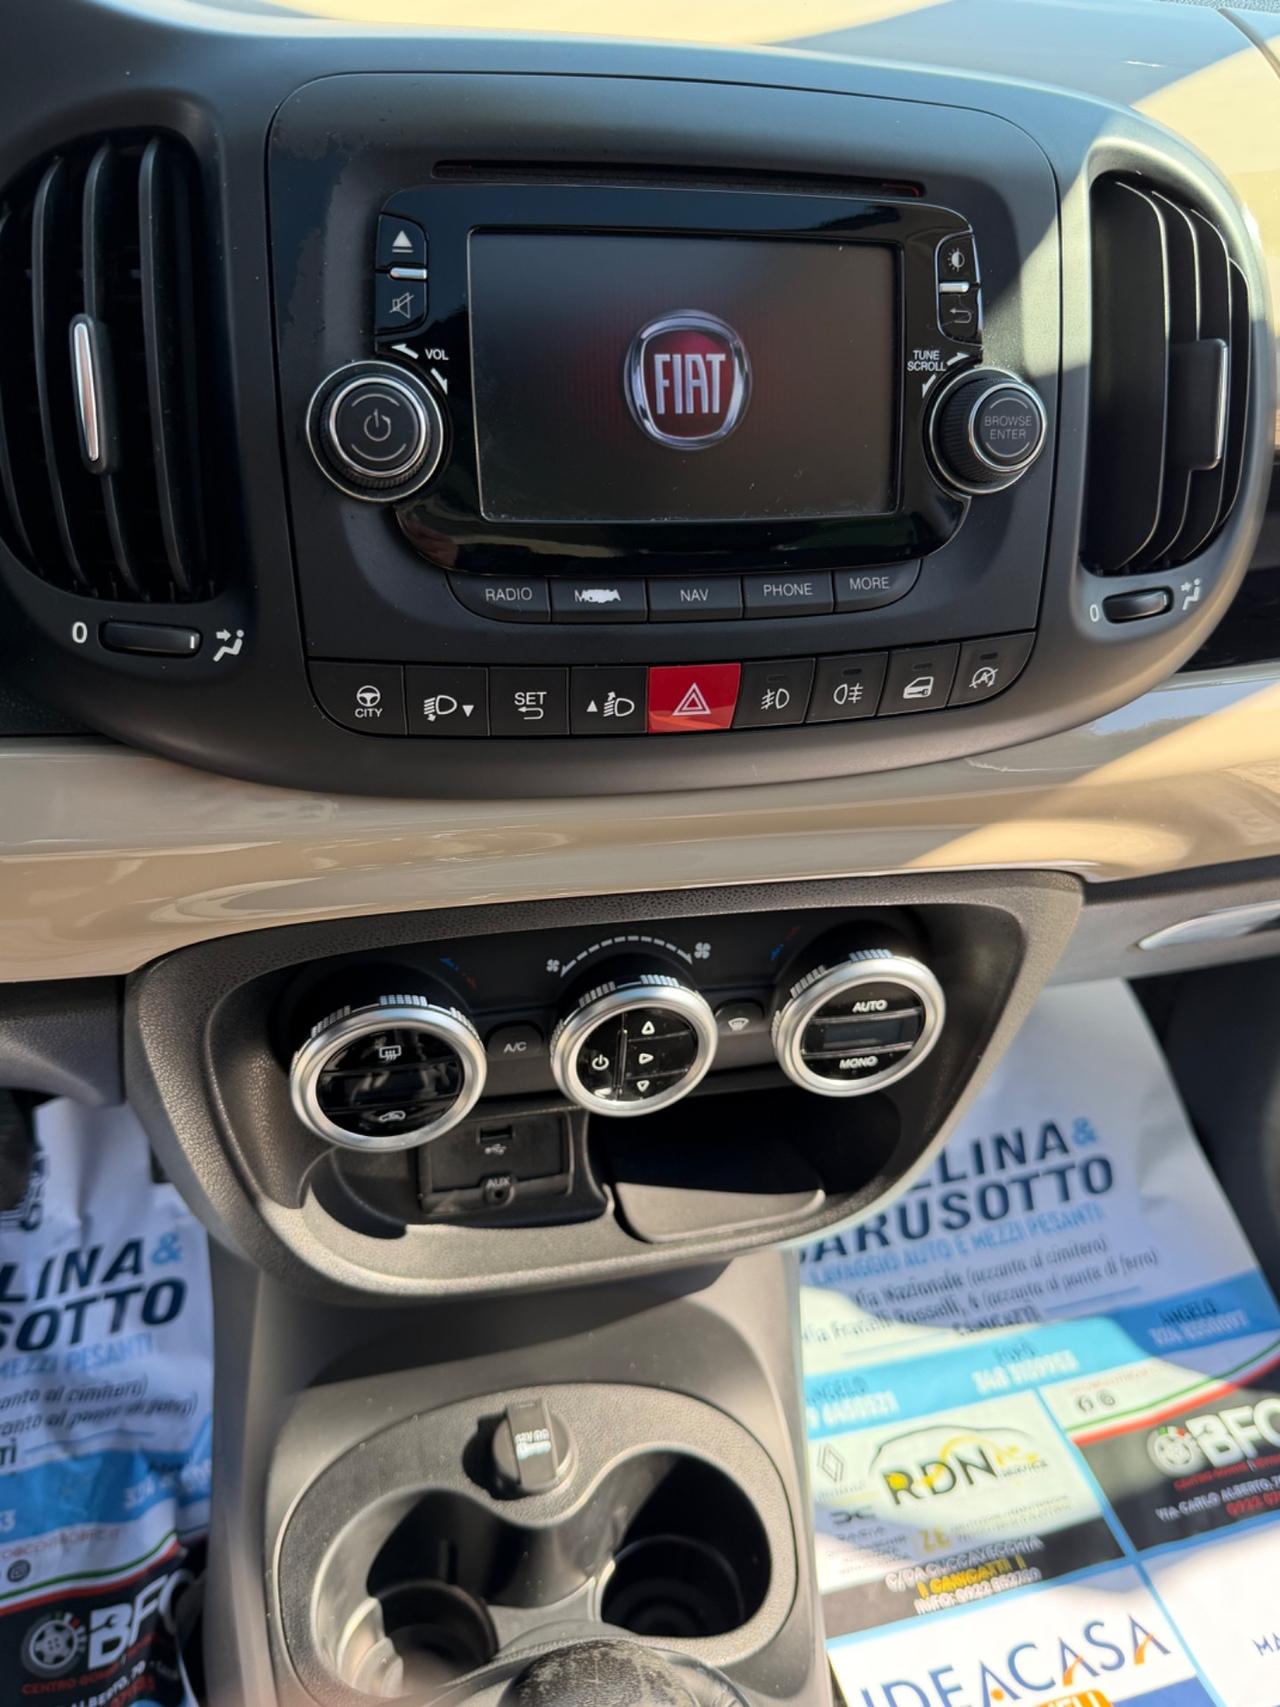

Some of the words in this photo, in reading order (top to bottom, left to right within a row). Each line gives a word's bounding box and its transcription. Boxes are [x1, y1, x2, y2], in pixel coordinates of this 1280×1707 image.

[424, 348, 449, 361] VOL
[913, 350, 940, 360] TUNE
[907, 361, 946, 372] SCROLL
[653, 353, 726, 415] FIAT
[984, 415, 1032, 427] BROWSE
[990, 429, 1026, 440] ENTER
[763, 582, 813, 599] PHONE
[849, 576, 891, 592] MORE
[485, 586, 533, 602] RADIO
[679, 588, 709, 602] NAV
[514, 690, 547, 706] SET
[354, 706, 383, 719] CITY
[852, 999, 888, 1013] AUTO
[503, 1041, 528, 1054] A/C
[839, 1055, 878, 1070] MONO
[912, 1119, 1070, 1190] LINA
[487, 1176, 510, 1188] AUX
[800, 1156, 1113, 1263] ARUSOTTO
[1155, 1505, 1180, 1522] VIA
